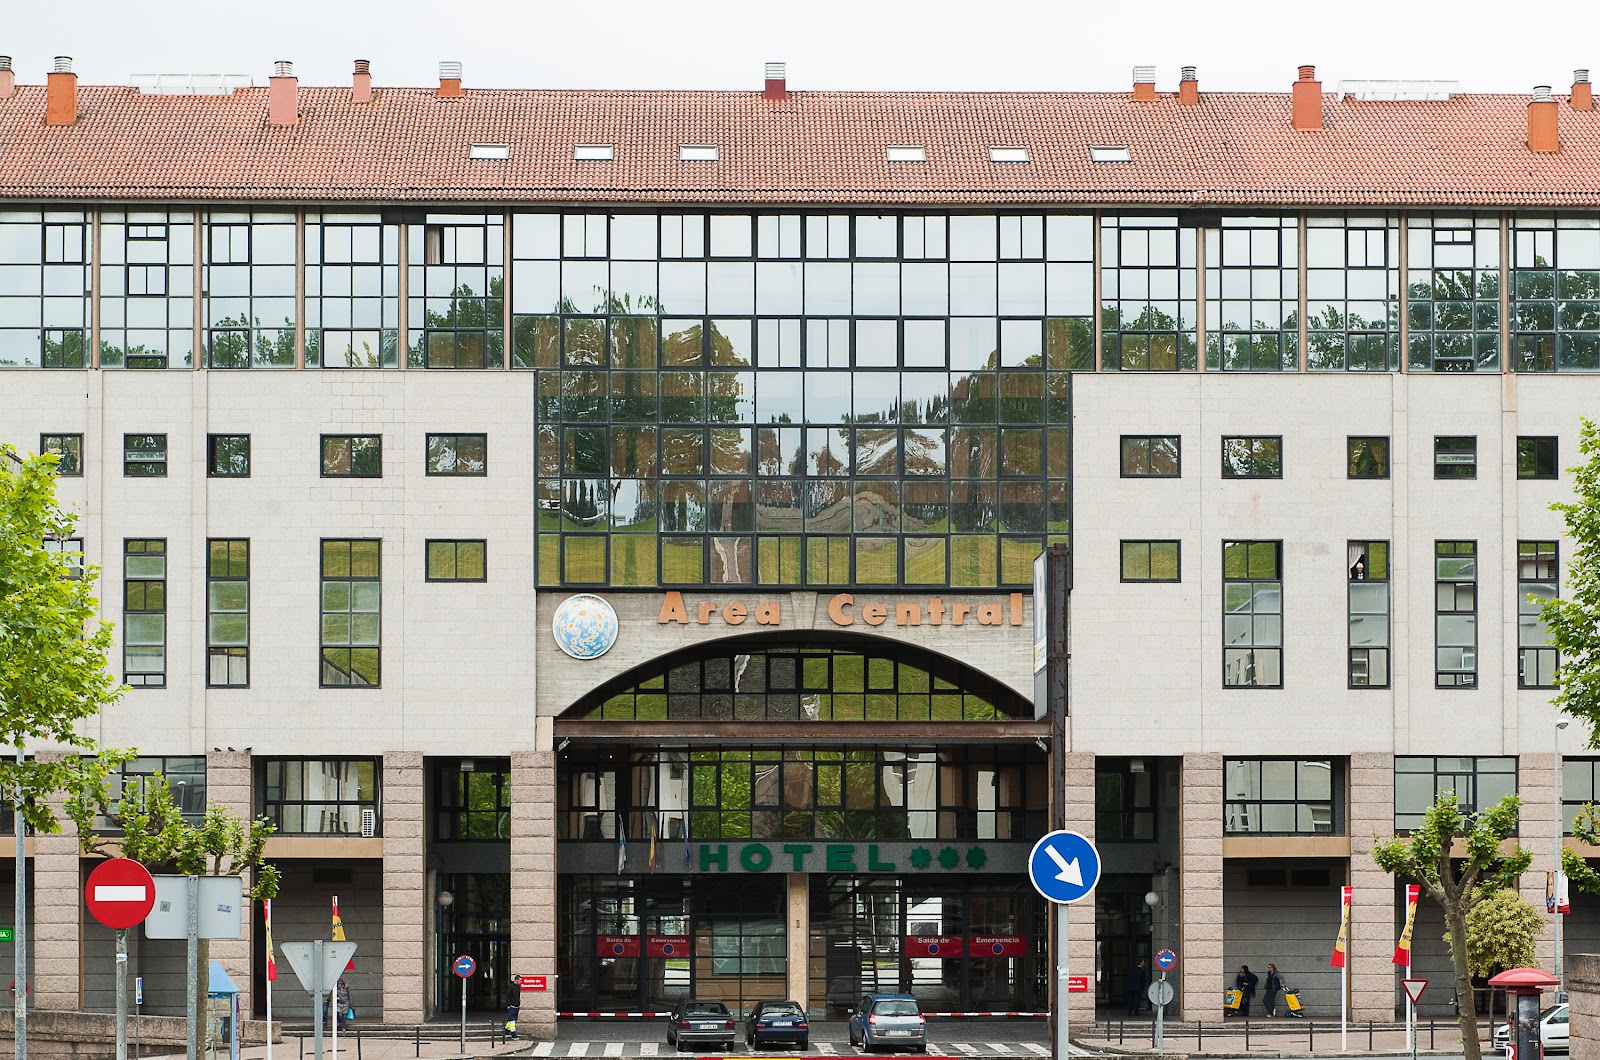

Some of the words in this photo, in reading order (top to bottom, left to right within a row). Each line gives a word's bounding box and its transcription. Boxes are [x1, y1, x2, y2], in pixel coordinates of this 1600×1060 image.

[658, 591, 780, 624] Area
[828, 592, 1022, 626] Central
[699, 843, 896, 872] HOTEL
[975, 936, 1020, 944] Emerxencia
